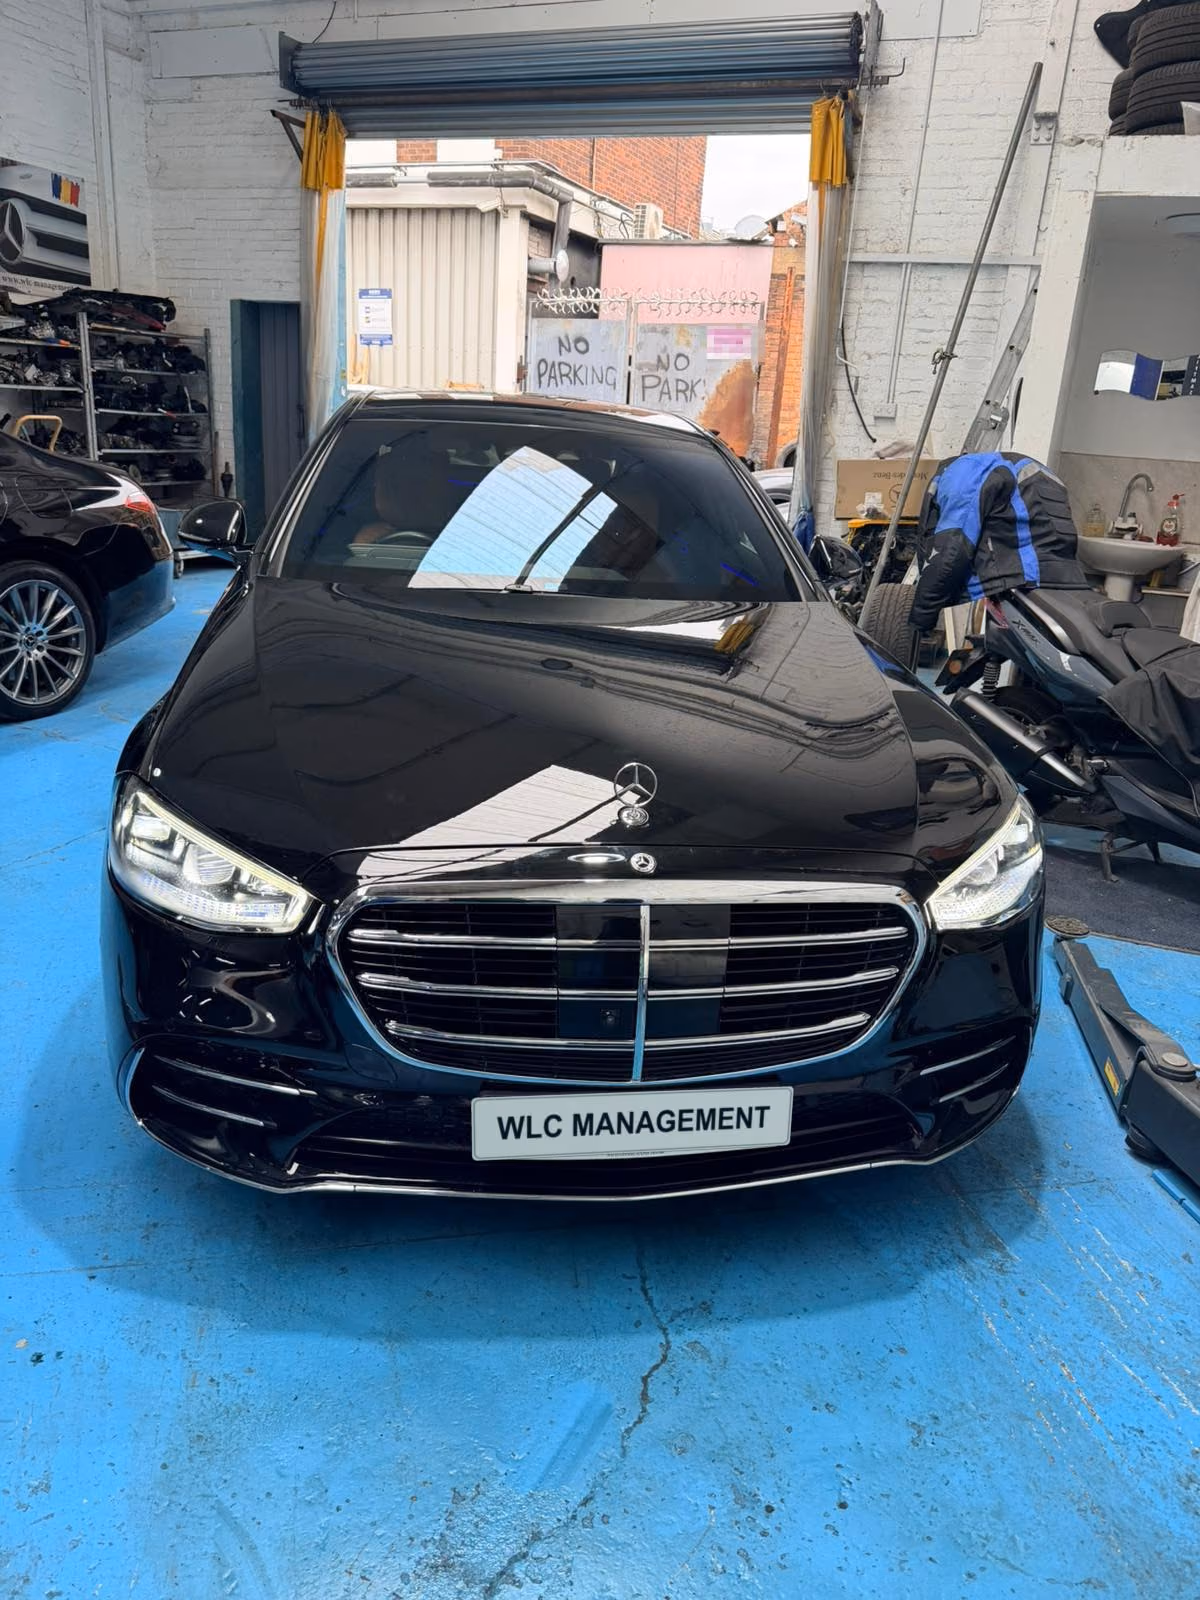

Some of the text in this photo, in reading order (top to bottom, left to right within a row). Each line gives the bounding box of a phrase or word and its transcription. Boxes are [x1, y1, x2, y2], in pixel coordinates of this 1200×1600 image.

[558, 334, 590, 356] NO
[537, 358, 617, 390] PARKING
[656, 353, 690, 372] NO
[497, 1106, 770, 1140] WLC MANAGEMENT
